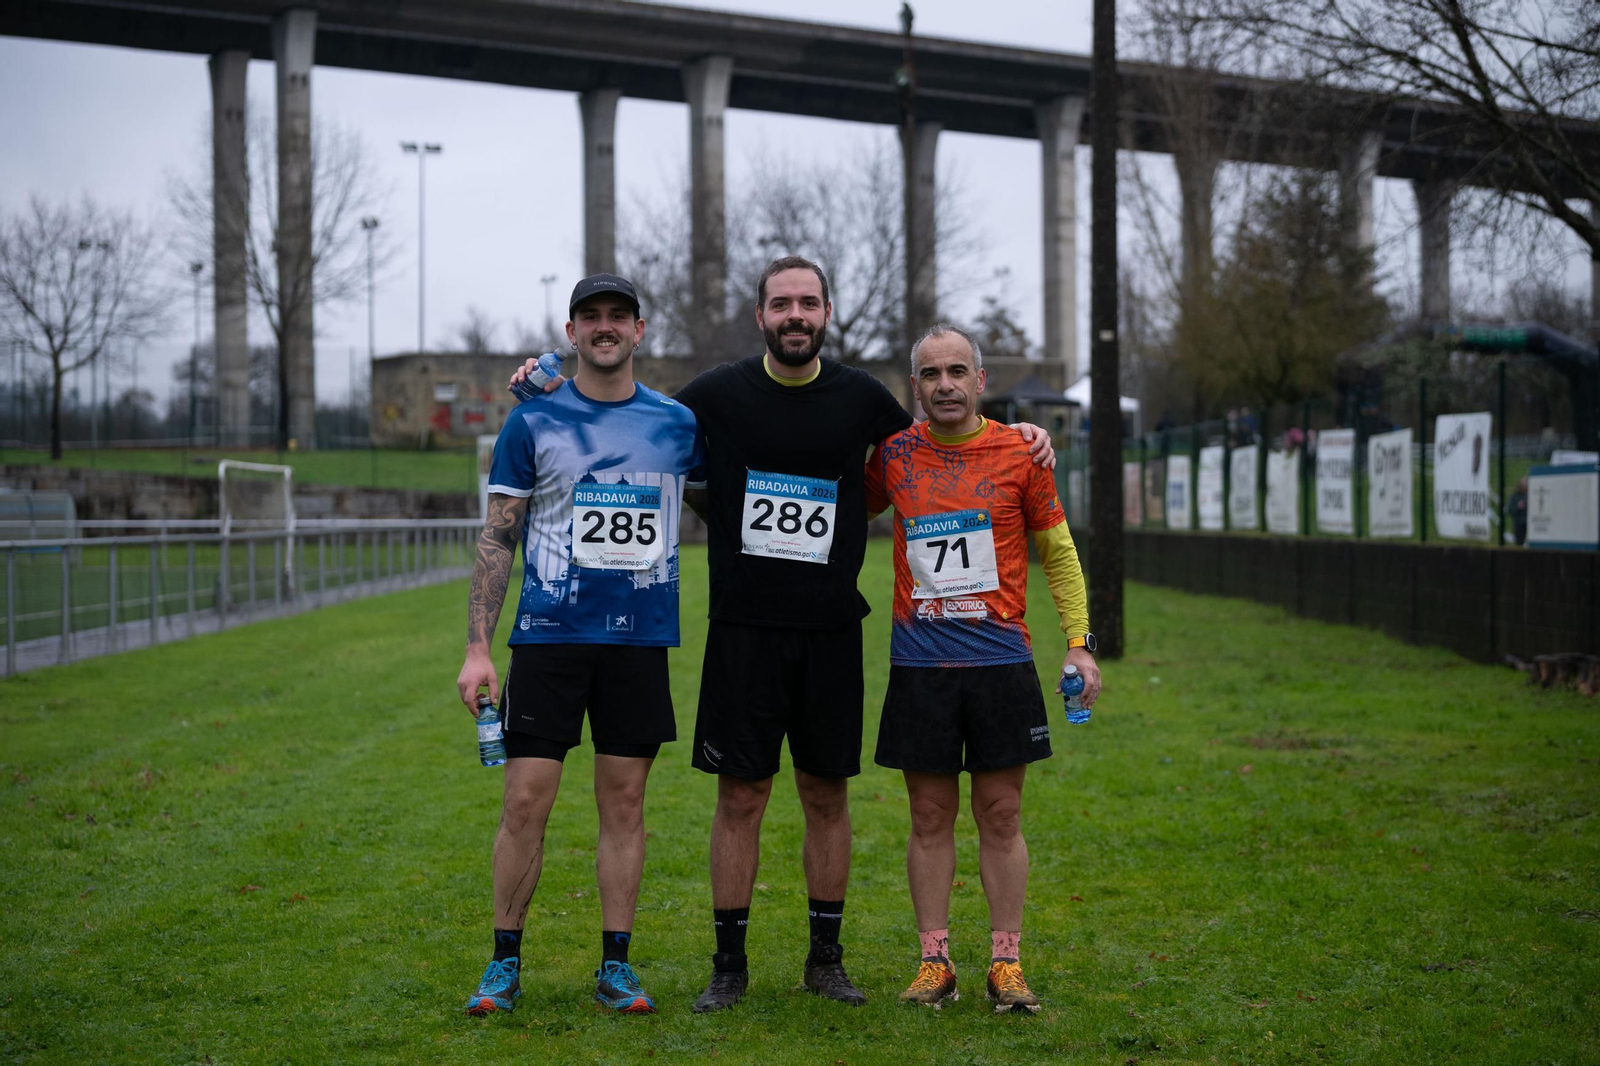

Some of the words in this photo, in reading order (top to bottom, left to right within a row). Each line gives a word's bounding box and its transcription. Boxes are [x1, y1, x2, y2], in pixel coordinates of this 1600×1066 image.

[575, 492, 636, 504] RIBADAVIA
[639, 494, 659, 504] 2026
[748, 479, 809, 496] RIBADAVIA
[812, 487, 836, 499] 2026
[581, 510, 656, 546] 285
[750, 498, 828, 538] 286
[906, 520, 960, 537] RIBADAVIA
[926, 537, 970, 573] 71
[947, 600, 987, 611] ESPOTRUCK
